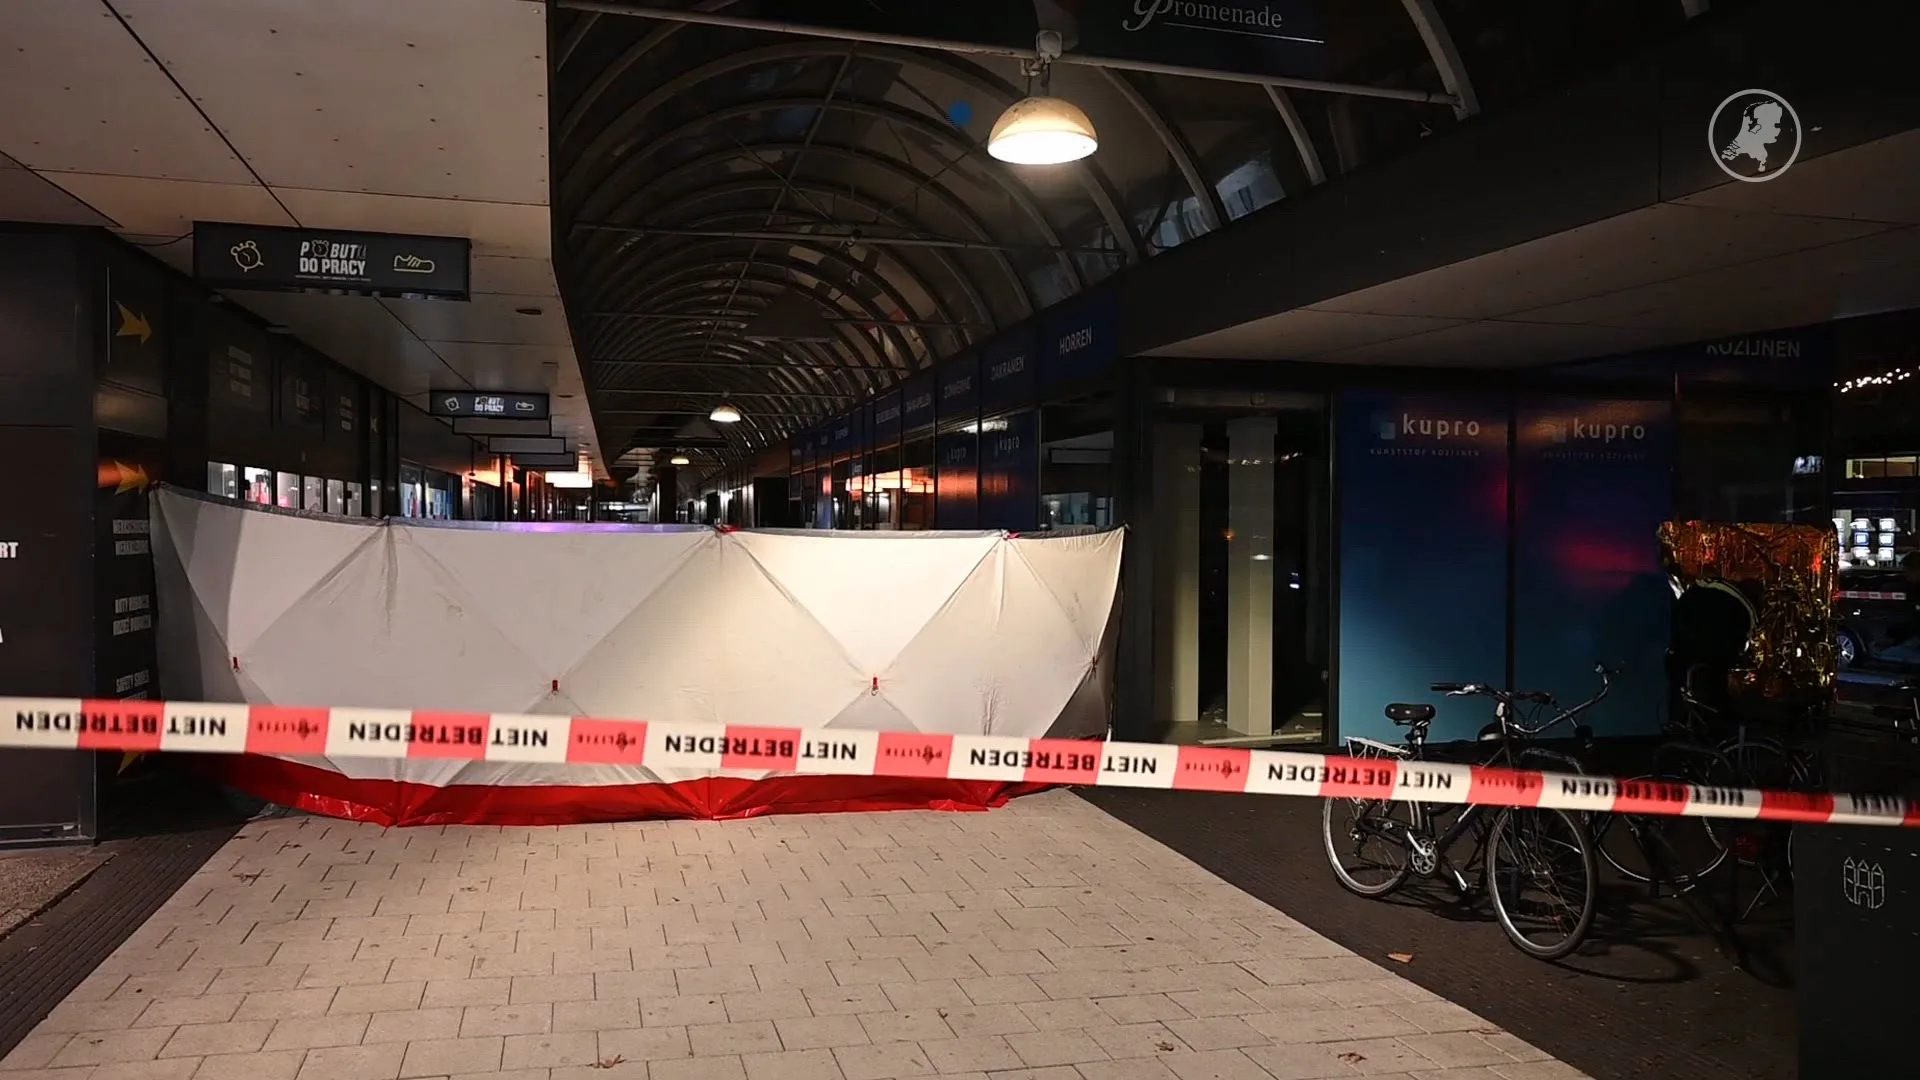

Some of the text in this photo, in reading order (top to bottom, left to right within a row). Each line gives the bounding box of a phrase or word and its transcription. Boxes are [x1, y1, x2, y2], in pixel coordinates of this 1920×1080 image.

[1122, 0, 1283, 31] Promenade
[300, 257, 366, 276] DO PRACY
[1060, 325, 1092, 355] HORREN
[1402, 413, 1480, 440] kupro
[1573, 419, 1645, 443] kupro
[16, 711, 158, 735] BETREDEN
[167, 716, 226, 736] NIET
[349, 723, 483, 745] BETREDEN
[491, 727, 548, 747] NIET
[665, 735, 794, 758] BETREDEN
[802, 741, 856, 760] NIET
[970, 748, 1095, 771] BETREDEN
[1103, 756, 1157, 774] NIET
[1268, 763, 1391, 786] BETREDEN
[1398, 771, 1452, 789] NIET
